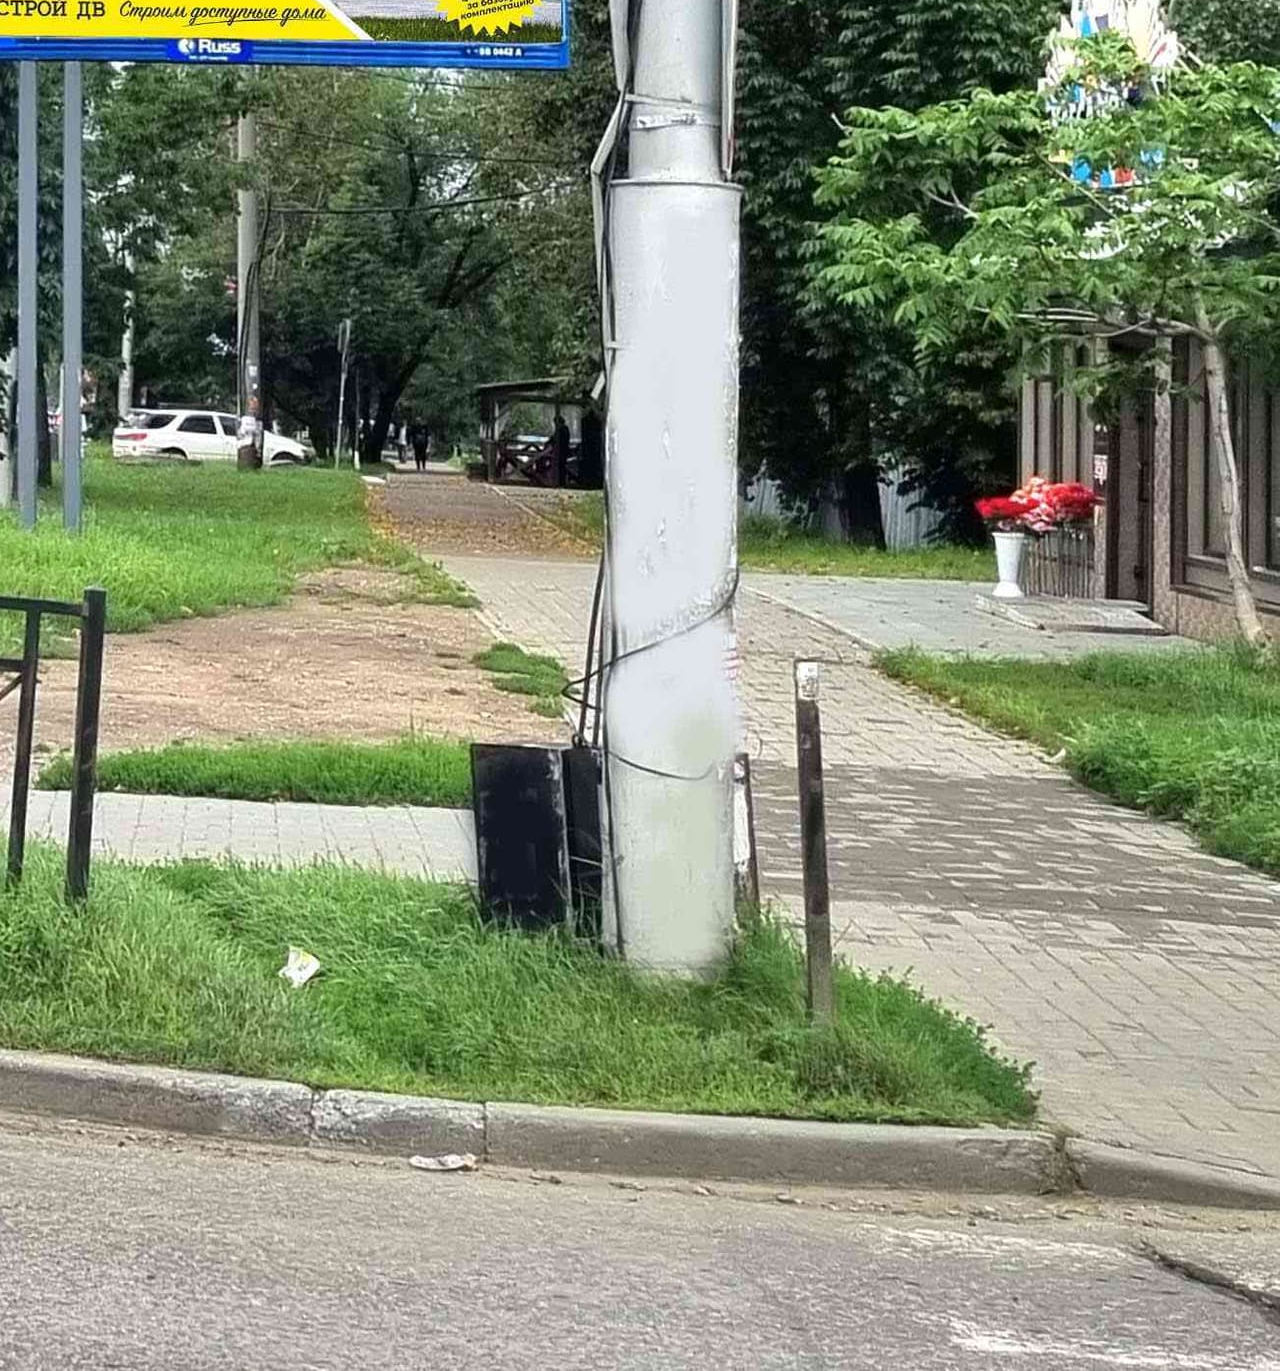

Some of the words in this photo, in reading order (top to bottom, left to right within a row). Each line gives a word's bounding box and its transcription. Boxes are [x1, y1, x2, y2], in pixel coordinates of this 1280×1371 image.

[77, 1, 106, 20] ДВ
[119, 0, 187, 21] Строим
[189, 6, 278, 26] доступные
[280, 7, 327, 27] дома
[467, 2, 479, 10] за
[198, 39, 241, 54] Russ
